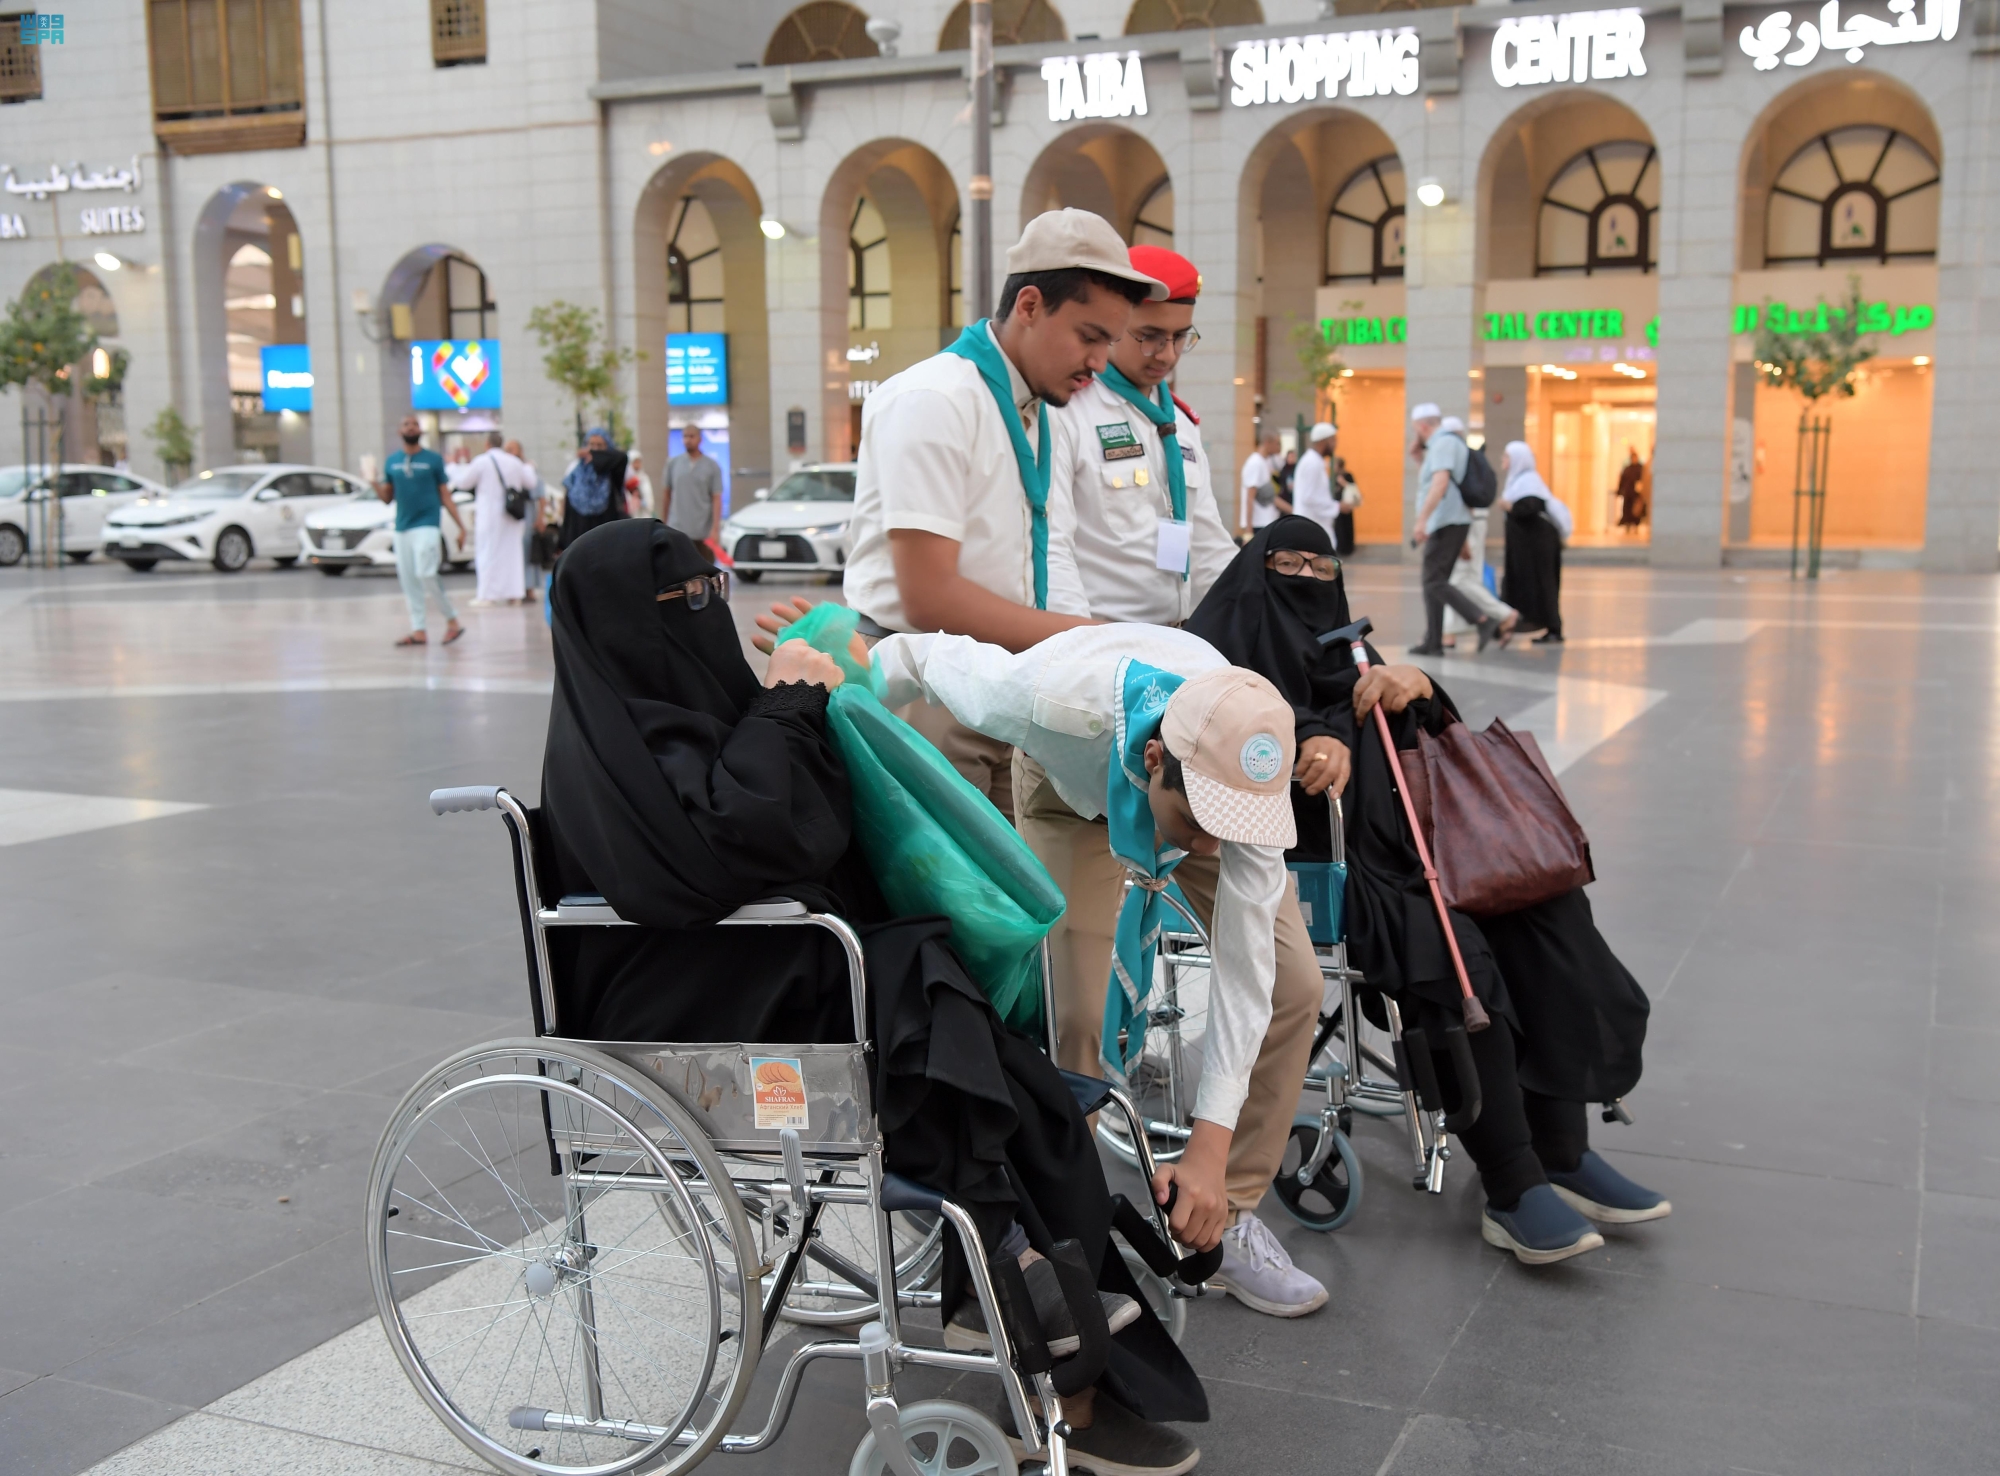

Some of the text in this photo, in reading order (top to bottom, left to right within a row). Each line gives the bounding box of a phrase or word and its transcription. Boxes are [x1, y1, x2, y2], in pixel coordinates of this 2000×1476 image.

[1739, 0, 1961, 71] التجاري
[1041, 13, 1647, 121] TAIBA SHOPPING CENTER
[0, 154, 142, 200] أجنحة طيبة
[80, 206, 145, 234] SUITES
[1320, 316, 1384, 345] TAIBA
[1534, 308, 1623, 340] CENTER
